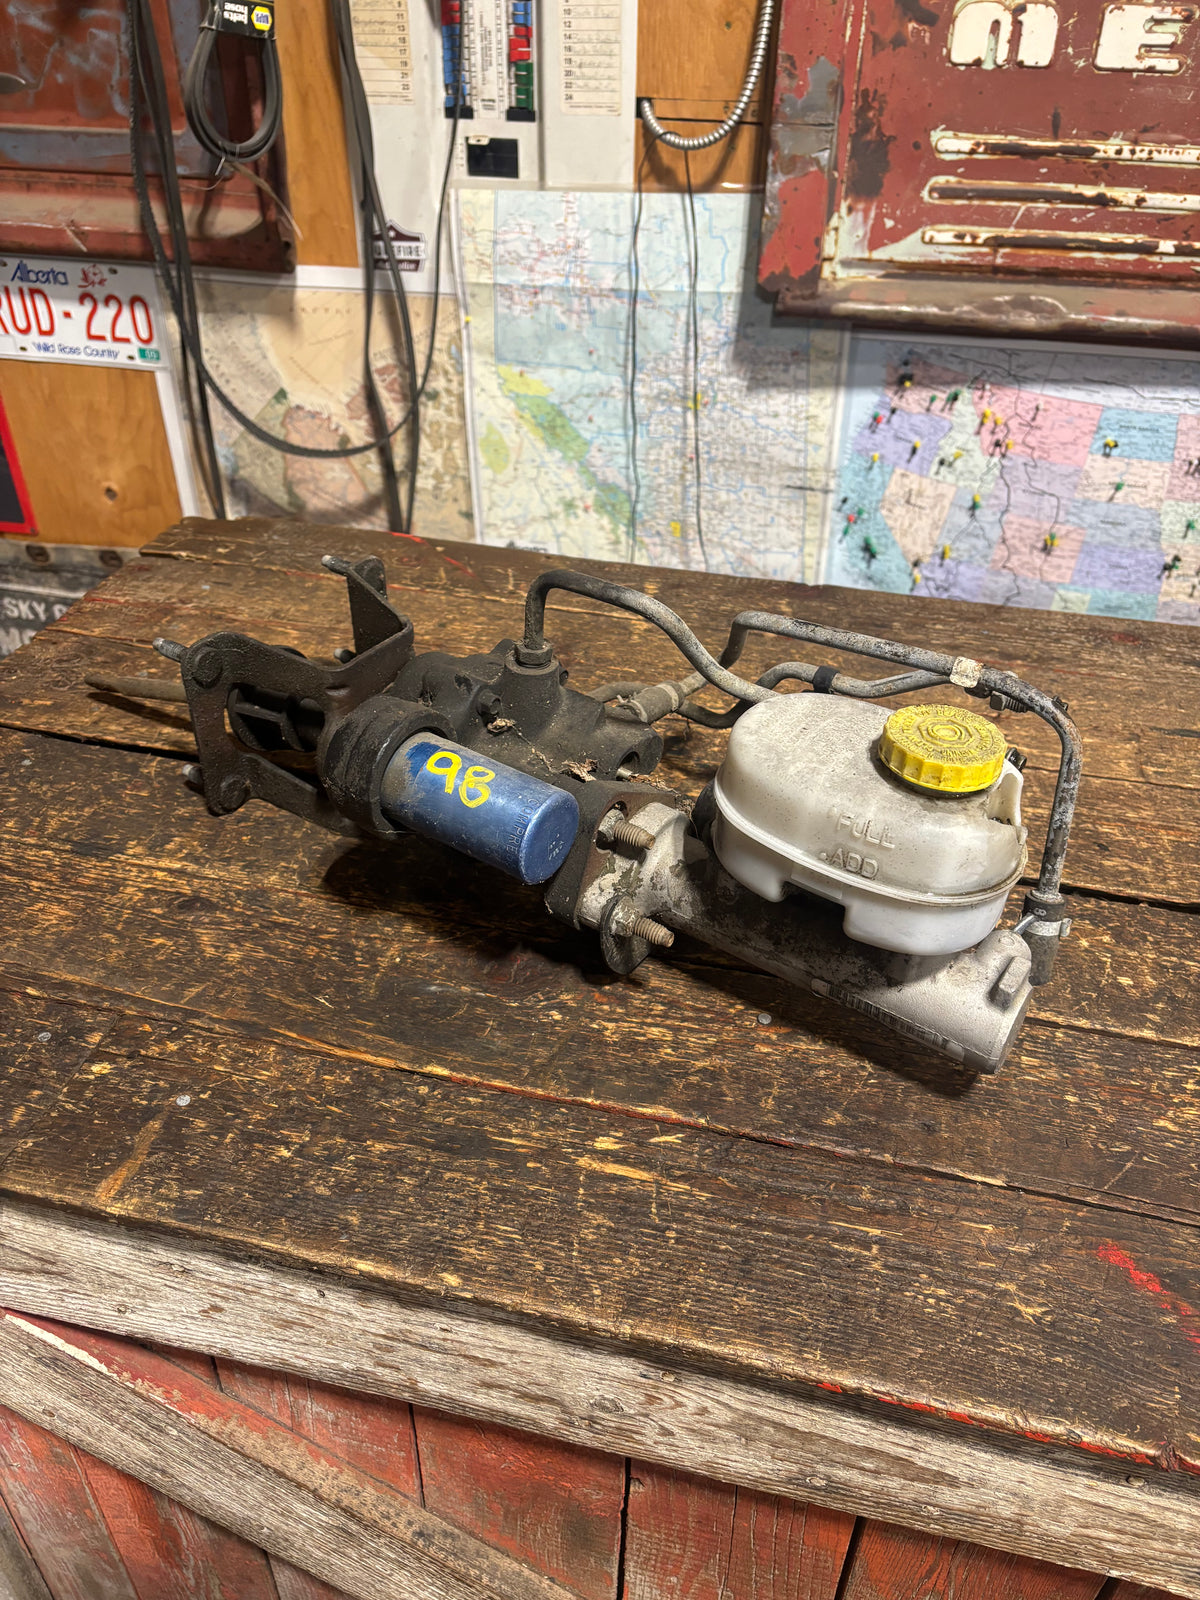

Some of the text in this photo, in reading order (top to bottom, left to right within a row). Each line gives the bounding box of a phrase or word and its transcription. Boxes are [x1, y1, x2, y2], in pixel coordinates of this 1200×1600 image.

[223, 11, 248, 24] belts
[224, 2, 248, 15] hose
[10, 260, 69, 285] Alberta
[33, 342, 120, 360] Wild Rose County
[3, 597, 47, 622] SKY
[426, 751, 496, 808] 98
[836, 812, 896, 850] FULL
[830, 847, 880, 881] ADD
